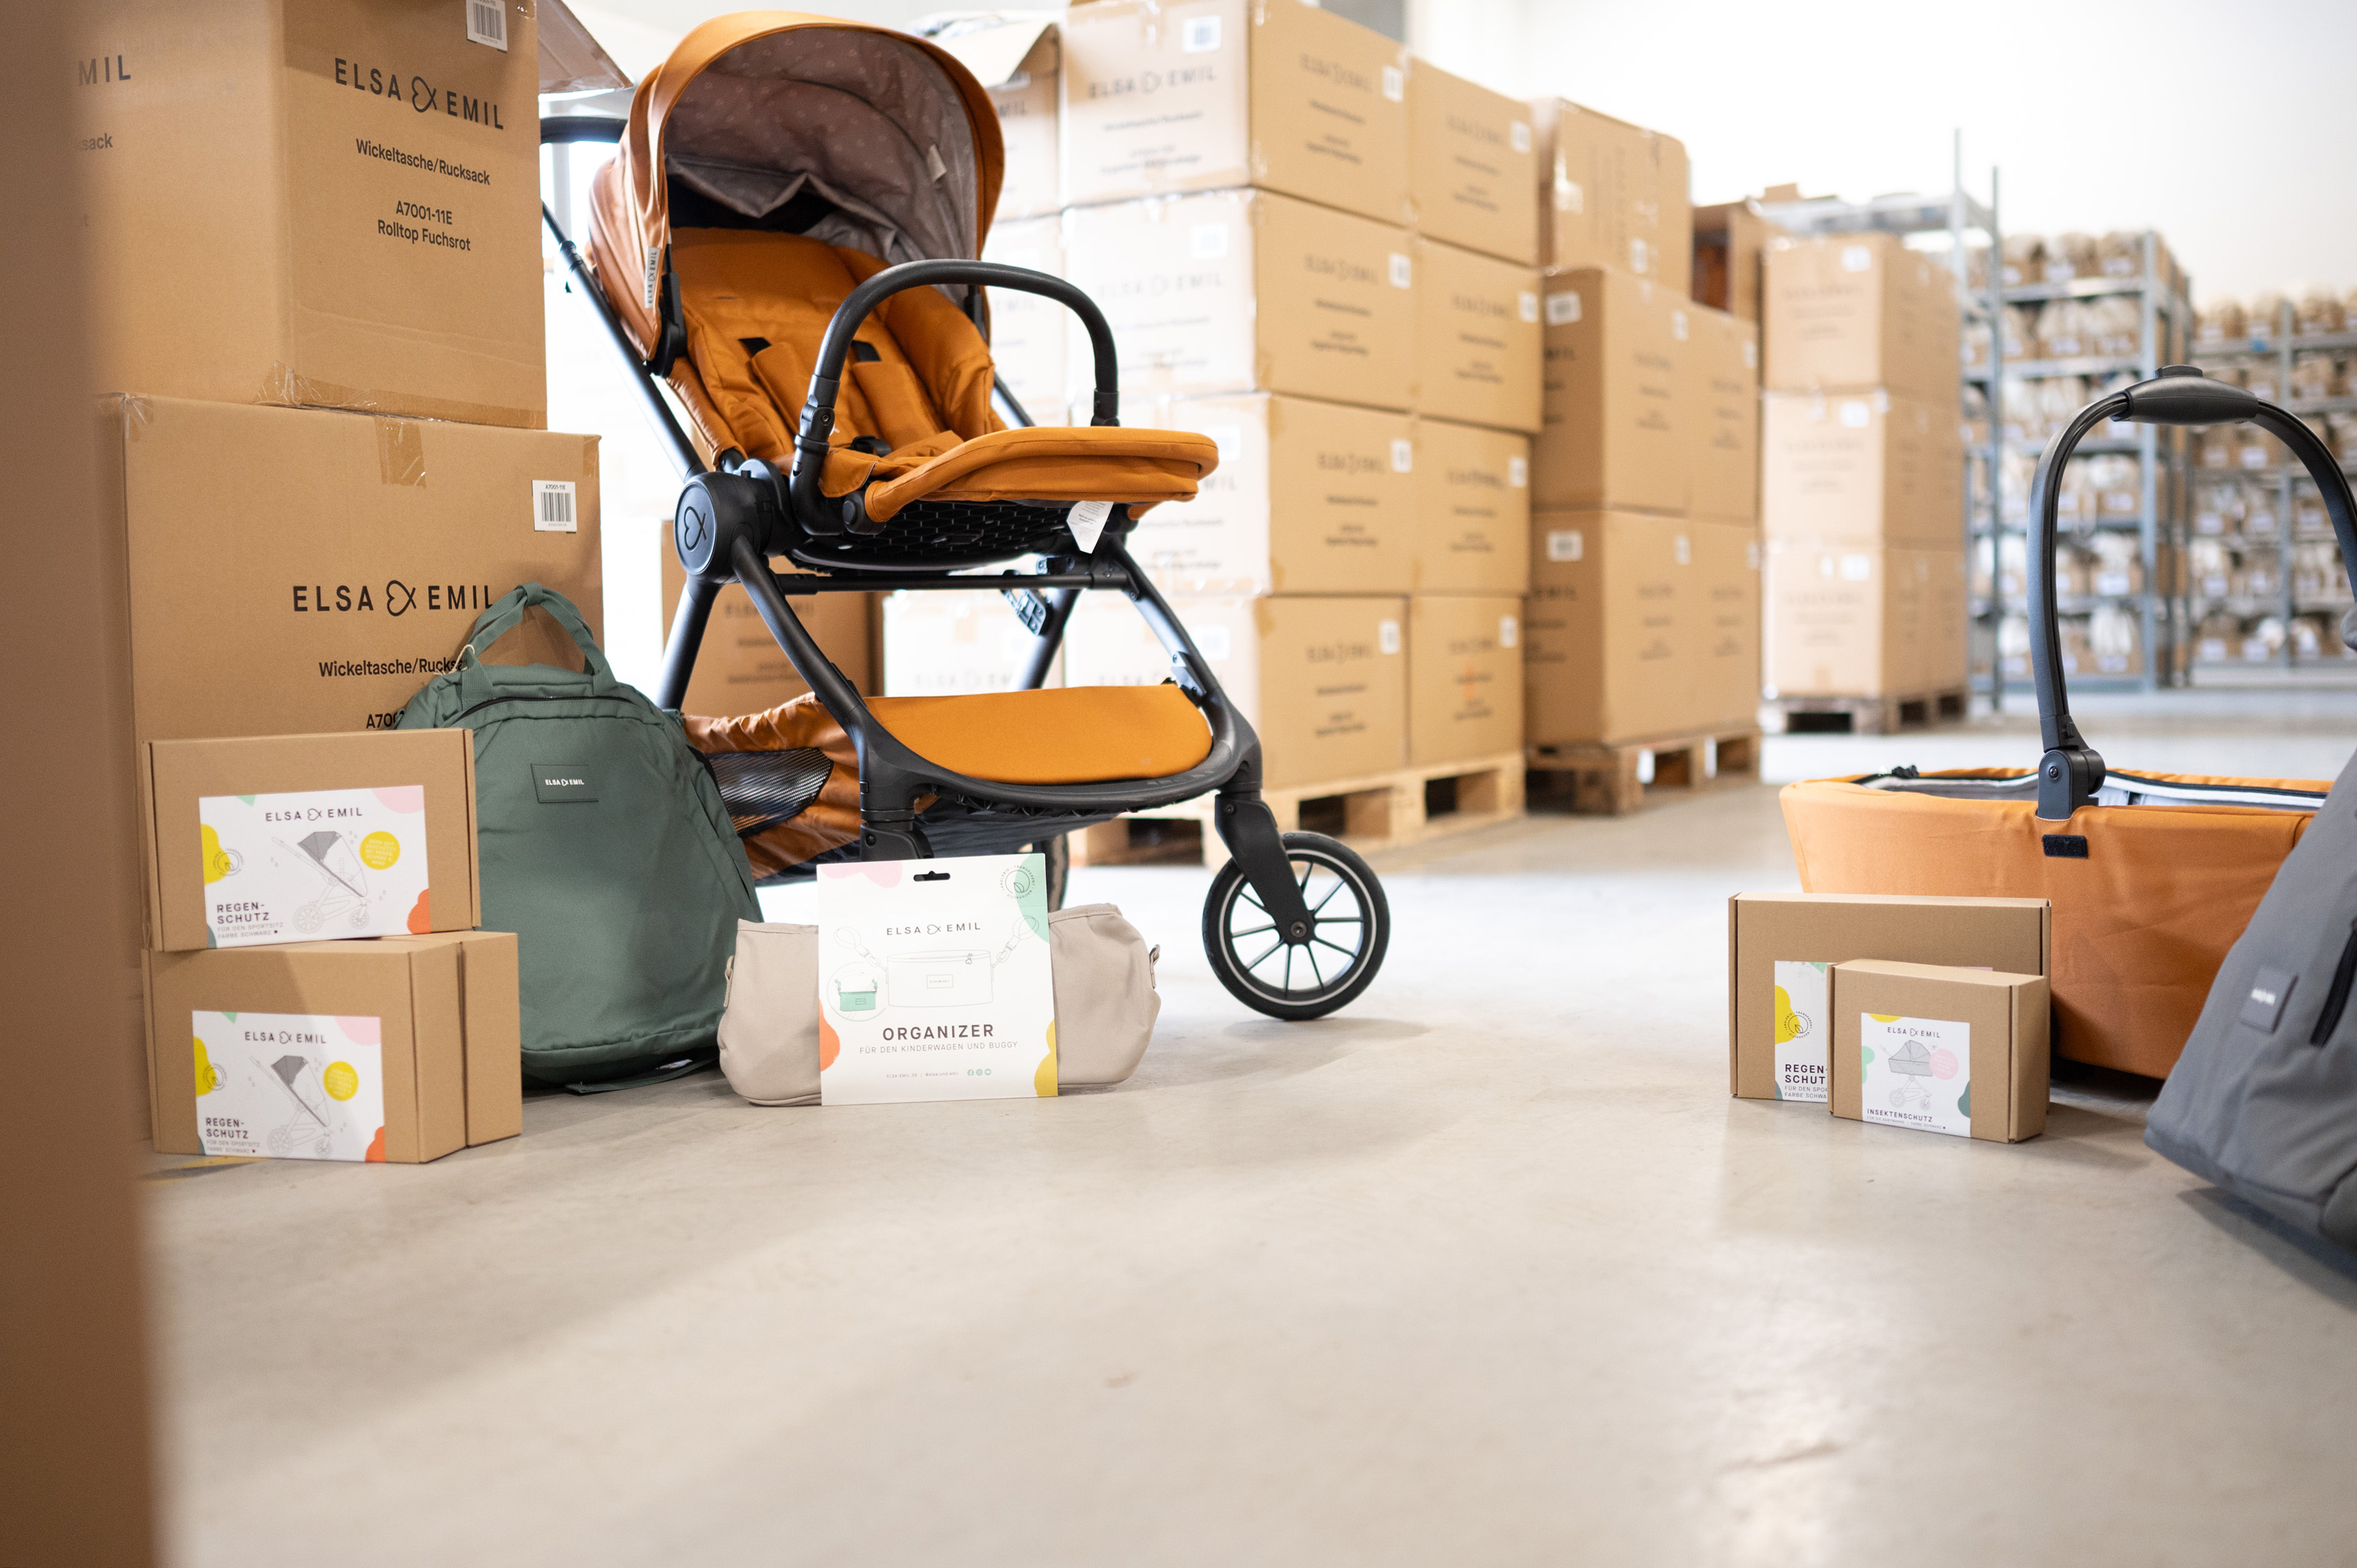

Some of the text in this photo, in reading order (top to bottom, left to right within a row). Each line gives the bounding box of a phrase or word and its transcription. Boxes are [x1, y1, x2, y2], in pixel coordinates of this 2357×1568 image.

[79, 55, 131, 86] MIL
[335, 58, 401, 101] ELSA
[447, 90, 503, 129] EMIL
[356, 138, 490, 185] Wickeltasche/Rucksack
[396, 200, 452, 225] A7001-11E
[378, 219, 471, 251] Rolltop Fuchsrot
[293, 585, 374, 611] ELSA
[428, 585, 493, 610] EMIL
[319, 657, 463, 677] Wickeltasche/Rucksa
[366, 713, 398, 729] A70
[265, 812, 301, 822] ELSA
[328, 807, 363, 818] EMIL
[217, 902, 265, 913] REGEN-
[217, 912, 269, 924] SCHUTZ
[887, 927, 921, 935] ELSA
[947, 922, 981, 932] EMIL
[245, 1032, 275, 1042] ELSA
[296, 1033, 326, 1043] EMIL
[883, 1024, 994, 1041] ORGANIZER
[860, 1045, 876, 1053] FÜR
[901, 1043, 964, 1052] KINDERWAGEN
[1785, 1075, 1825, 1084] SCHUT
[206, 1117, 244, 1127] REGEN-
[1867, 1108, 1932, 1122] INSEKTENSCHUTZ
[206, 1128, 248, 1139] SCHUTZ
